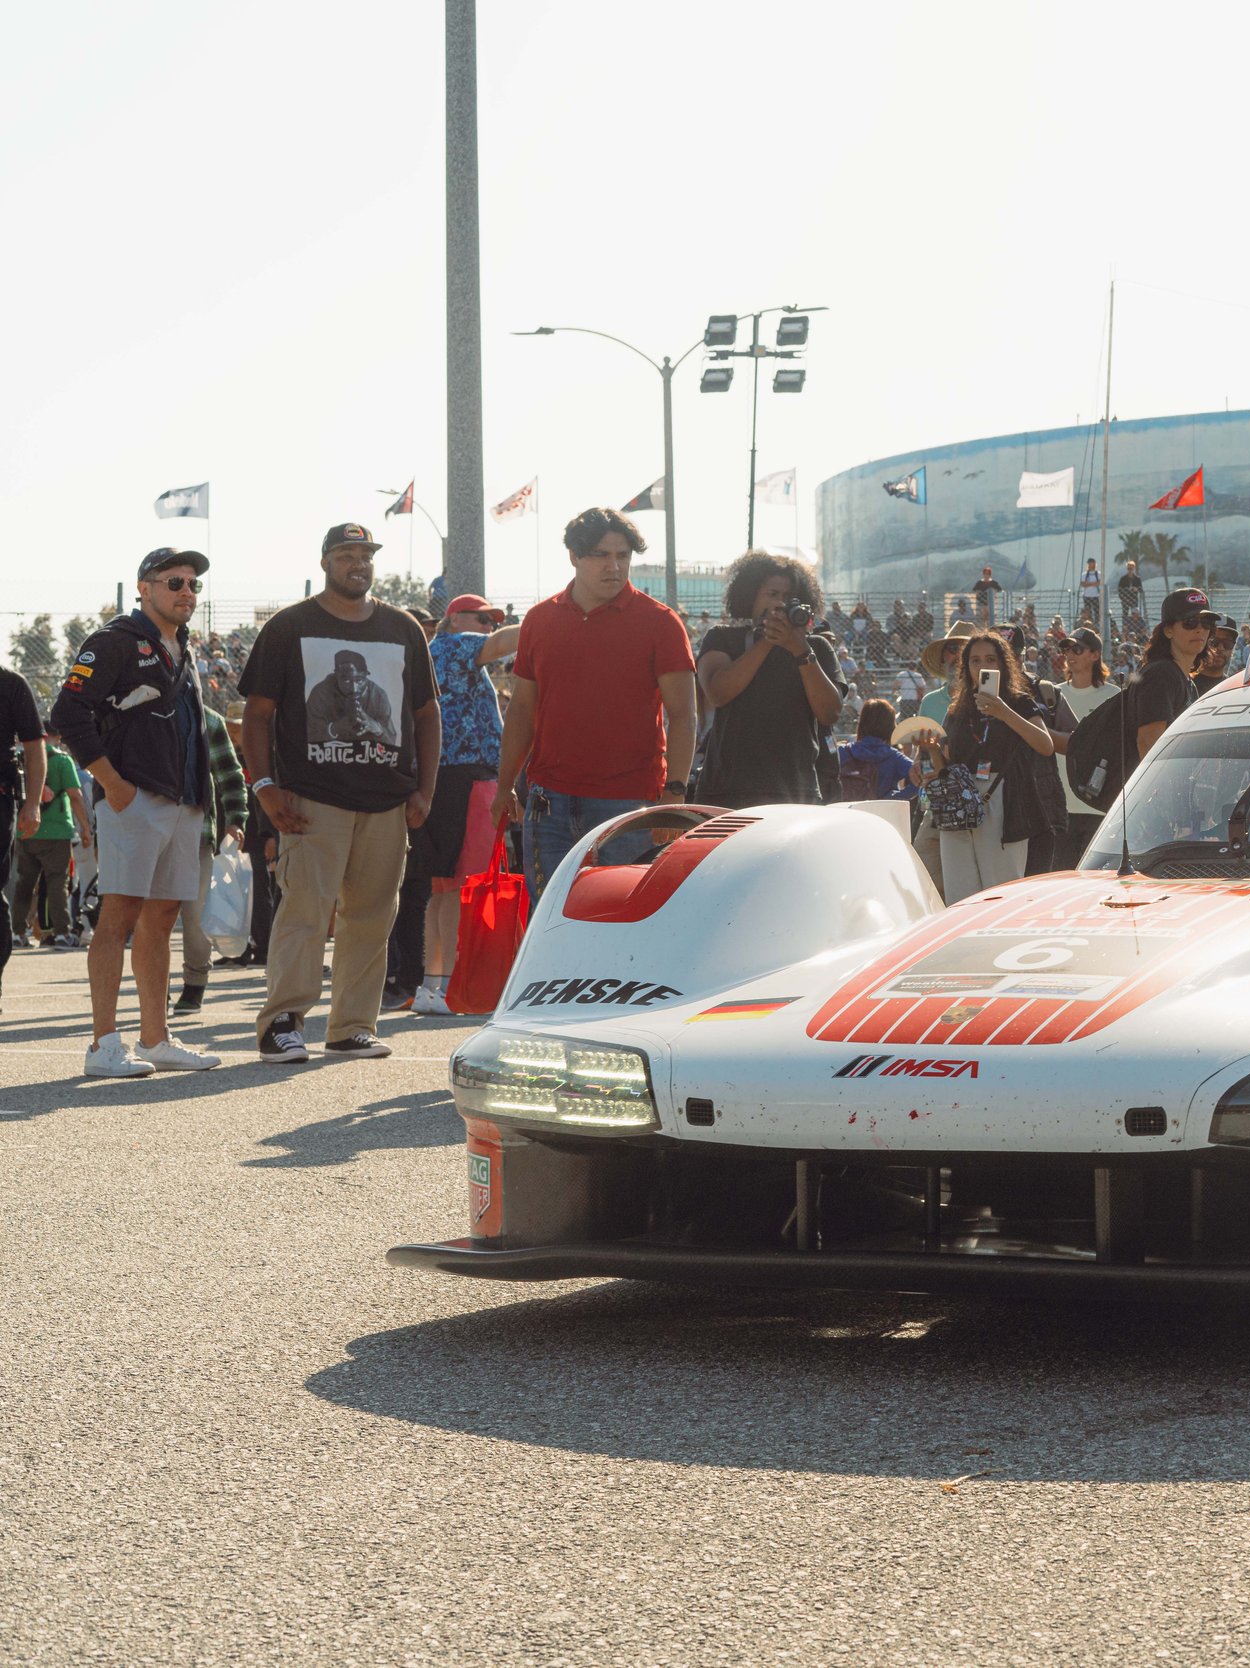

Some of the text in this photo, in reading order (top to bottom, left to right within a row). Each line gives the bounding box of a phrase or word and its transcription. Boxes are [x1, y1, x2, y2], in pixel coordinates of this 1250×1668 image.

[993, 937, 1089, 970] 6
[506, 978, 685, 1012] PENSKE
[879, 1058, 979, 1079] IMSA
